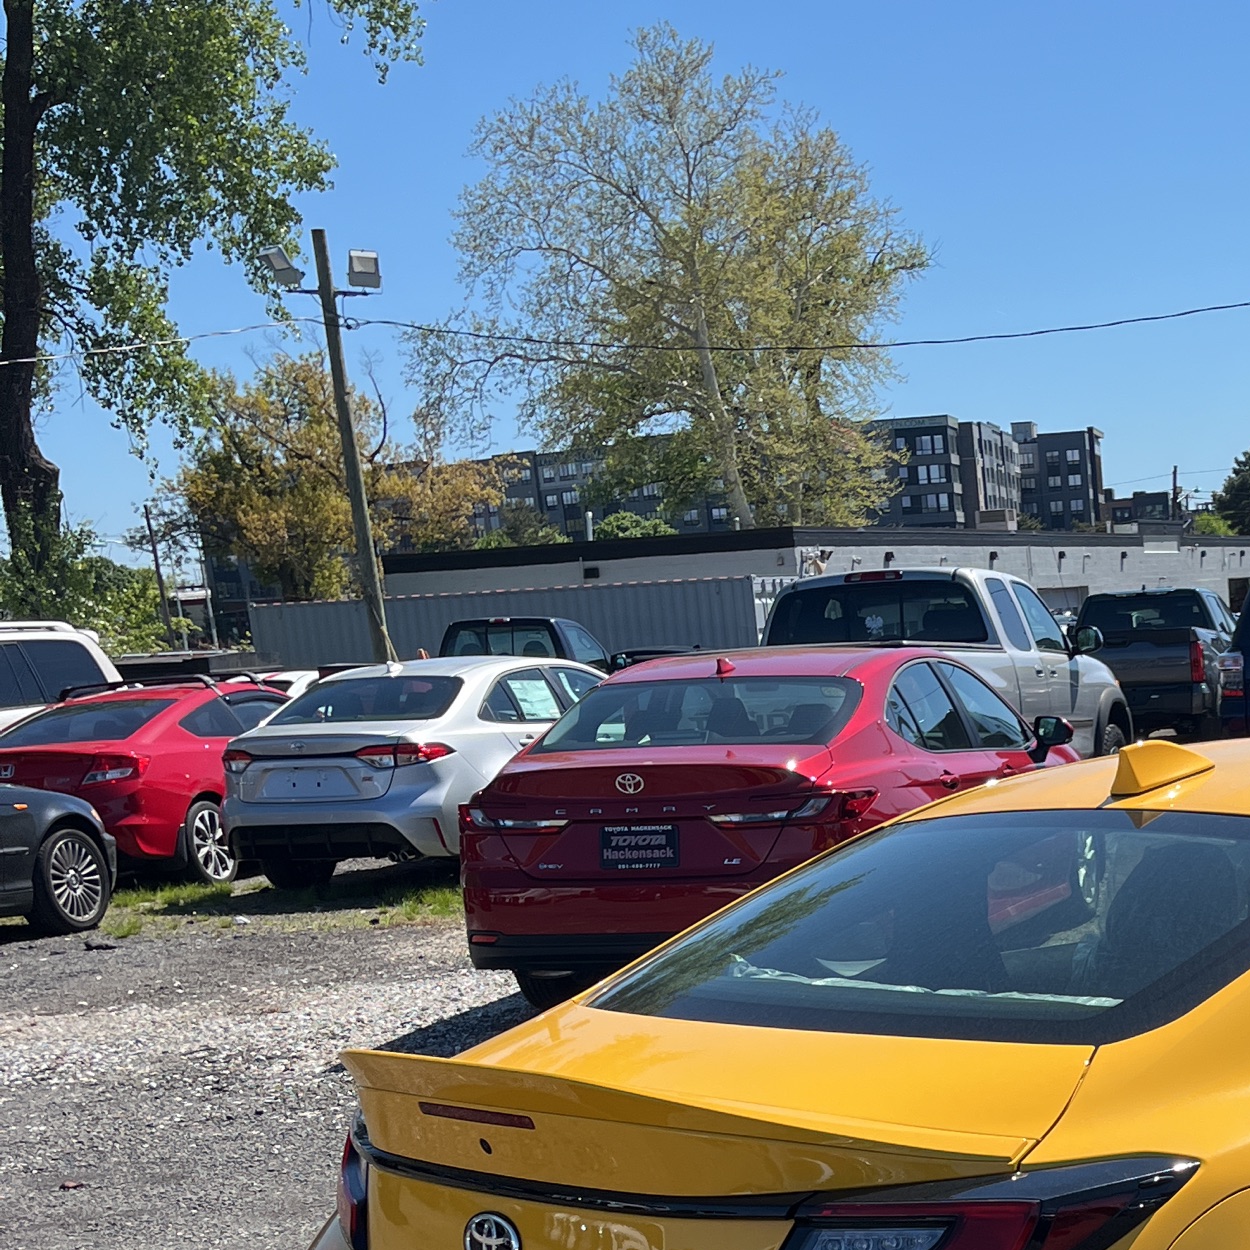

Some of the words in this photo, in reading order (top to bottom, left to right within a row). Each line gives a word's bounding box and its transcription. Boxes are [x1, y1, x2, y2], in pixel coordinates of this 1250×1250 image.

[610, 834, 667, 847] TOYOTA
[603, 846, 675, 860] Hackensack
[723, 857, 741, 865] LE
